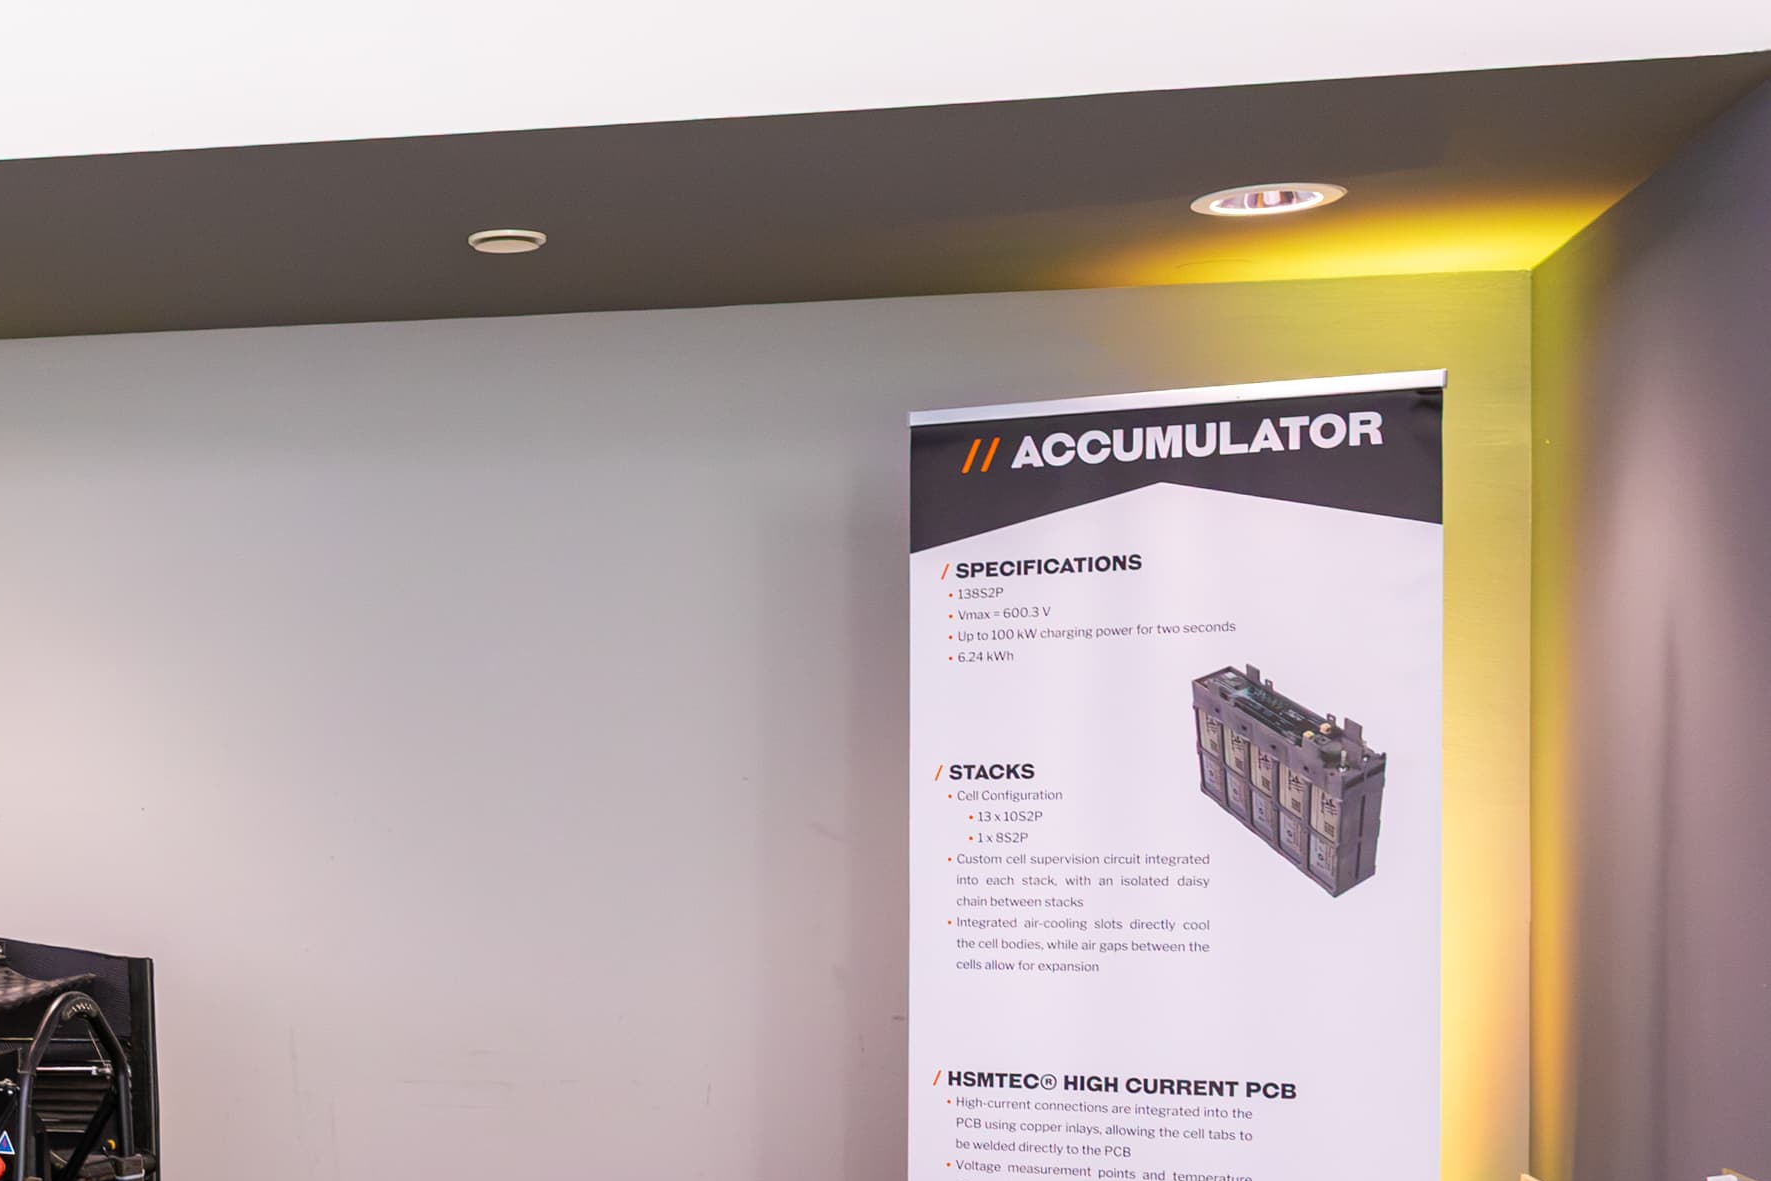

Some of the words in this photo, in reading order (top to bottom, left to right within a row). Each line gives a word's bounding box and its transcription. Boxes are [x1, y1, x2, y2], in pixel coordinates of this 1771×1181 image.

[1010, 411, 1384, 469] ACCUMULATOR
[955, 553, 1143, 579] SPECIFICATIONS
[958, 586, 1004, 600] 138S2P
[957, 609, 991, 621] Vmax
[1002, 606, 1040, 619] 600.3
[1041, 605, 1052, 617] V
[957, 631, 975, 644] Up
[976, 631, 989, 641] to
[991, 628, 1015, 641] 100
[1016, 628, 1038, 640] kW
[1039, 626, 1093, 640] charging
[1095, 626, 1133, 639] power
[1136, 623, 1154, 636] for
[1156, 624, 1181, 635] two
[1182, 620, 1237, 634] seconds
[957, 651, 984, 663] 6.24
[986, 650, 1014, 662] kWh
[948, 763, 1035, 781] STACKS
[956, 790, 979, 802] Cell
[981, 789, 1063, 803] Configuration
[977, 810, 992, 823] 13
[994, 813, 1002, 822] x
[1003, 810, 1043, 822] 10S2P
[956, 853, 1003, 865] Custom
[1005, 853, 1027, 865] cell
[1029, 853, 1100, 866] supervision
[1103, 853, 1141, 865] circuit
[1144, 853, 1211, 868] integrated
[956, 916, 1018, 930] Integrated
[1023, 917, 1088, 932] air-cooling
[1093, 918, 1124, 930] slots
[1129, 919, 1176, 932] directly
[1182, 919, 1211, 931] cool
[1063, 1074, 1119, 1093] HIGH
[1125, 1077, 1240, 1098] CURRENT
[1245, 1081, 1297, 1100] PCB
[955, 1095, 1031, 1110] High-current
[1034, 1101, 1109, 1114] connections
[1110, 1105, 1132, 1115] are
[1134, 1103, 1201, 1119] integrated
[1203, 1106, 1229, 1119] into
[1231, 1107, 1253, 1120] the
